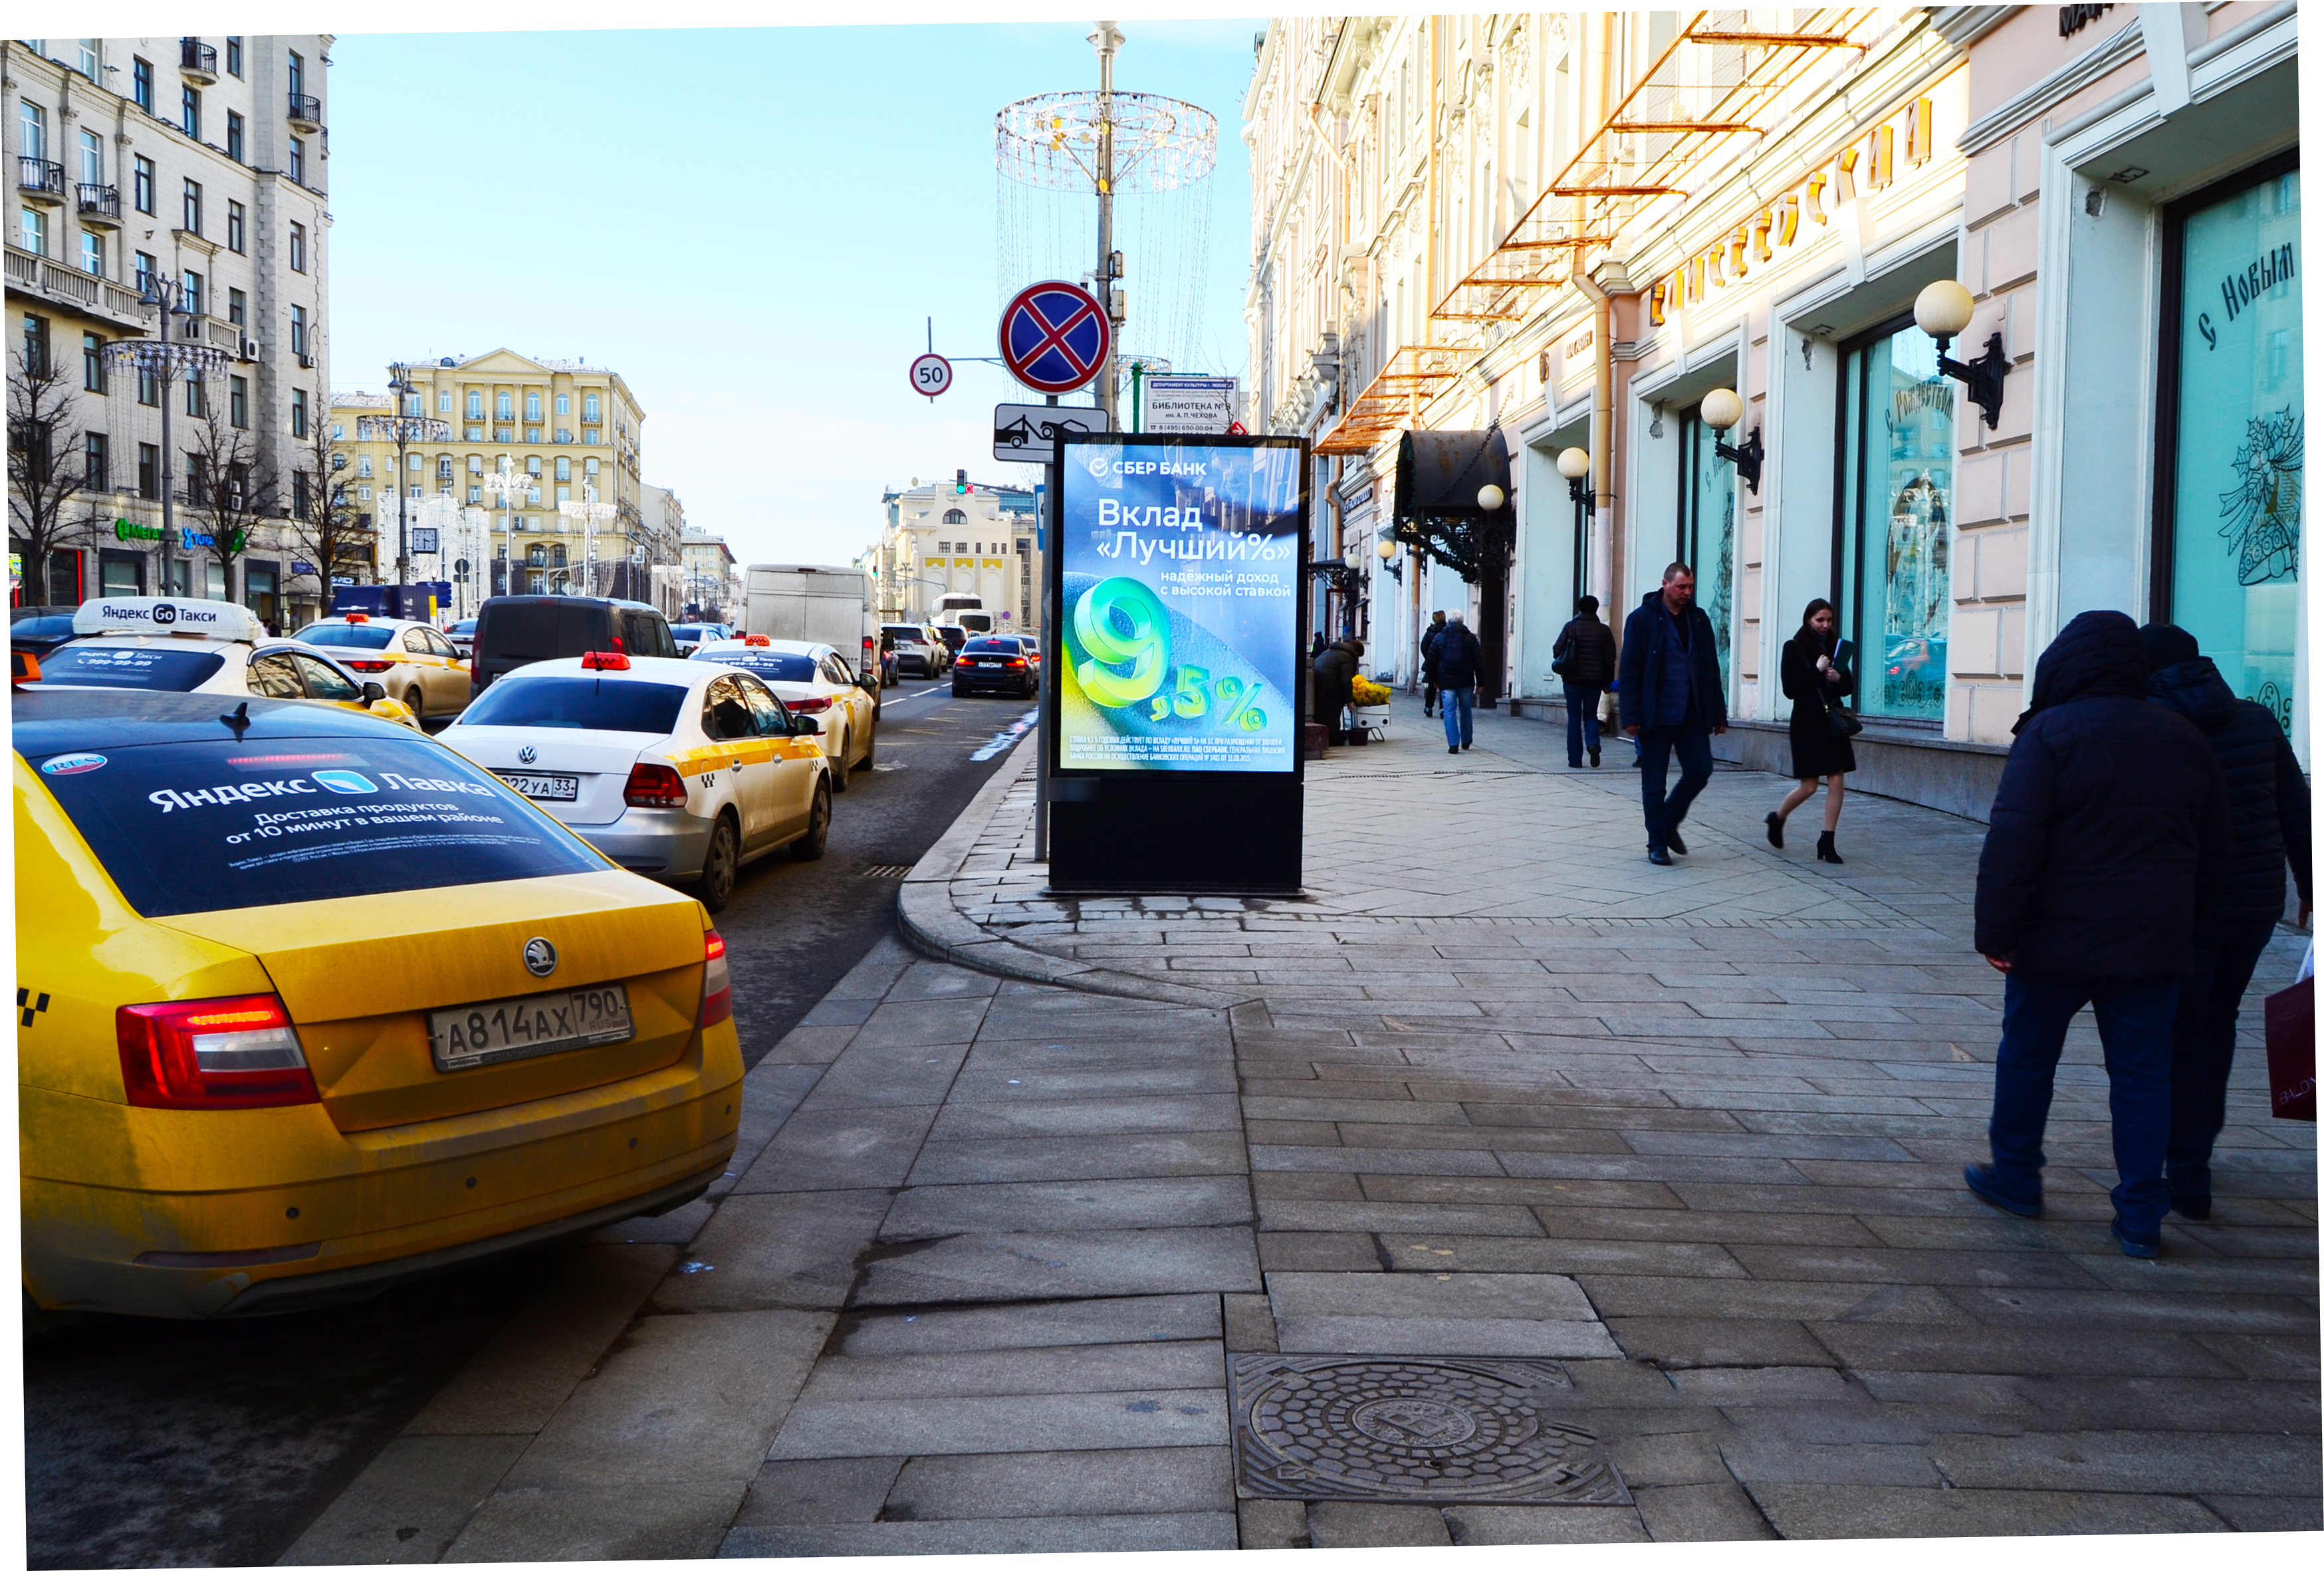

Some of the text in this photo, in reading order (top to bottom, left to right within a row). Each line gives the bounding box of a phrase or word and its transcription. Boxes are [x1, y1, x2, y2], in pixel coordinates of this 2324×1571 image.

[919, 367, 943, 383] 50
[1113, 461, 1207, 476] СБЕР БАНК
[1098, 498, 1203, 532] Вклад
[1096, 531, 1292, 566] «Лучший%»
[1160, 569, 1279, 585] надёжный доход
[1160, 583, 1292, 597] с высокой ставкой
[102, 605, 217, 622] Яндекс Go Такси
[134, 652, 162, 661] Такси
[52, 757, 98, 771] RUS
[148, 773, 497, 813] Яндекс Лавка
[554, 779, 570, 791] 33
[254, 803, 459, 827] Доставка продуктов
[225, 812, 505, 844] от 10 минут в вашем районе
[447, 990, 618, 1055] А814АХ 790
[589, 1019, 612, 1031] RUS
